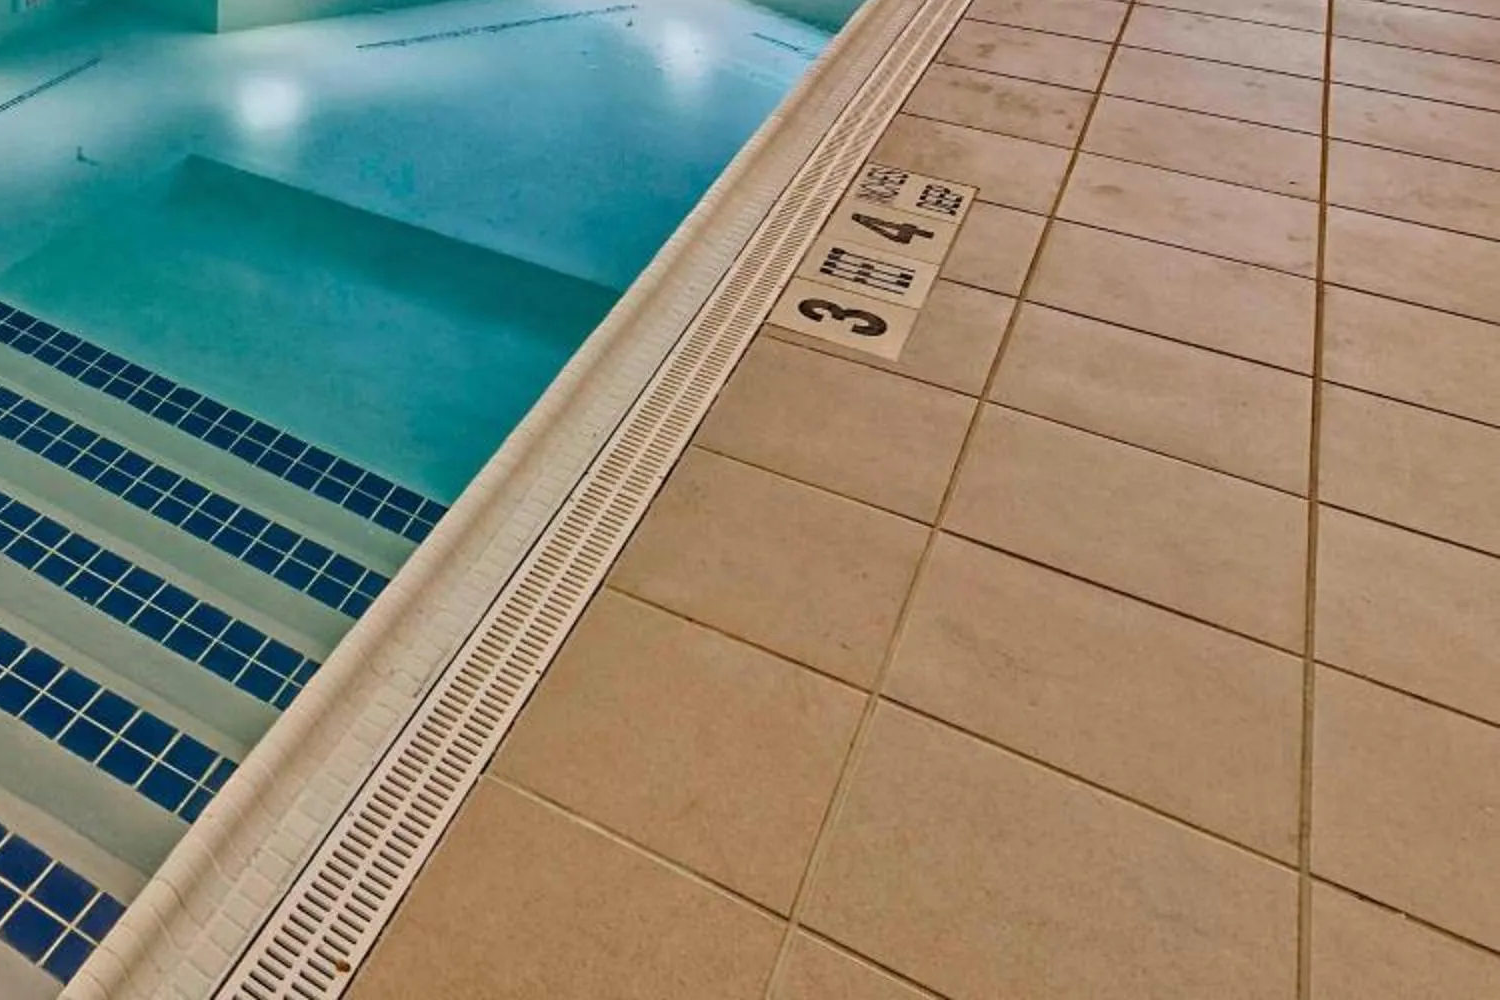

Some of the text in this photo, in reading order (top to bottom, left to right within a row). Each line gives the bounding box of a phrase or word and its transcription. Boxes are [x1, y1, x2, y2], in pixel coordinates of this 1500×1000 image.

[851, 212, 935, 245] 4
[819, 246, 917, 297] FEET
[797, 298, 888, 337] 3
